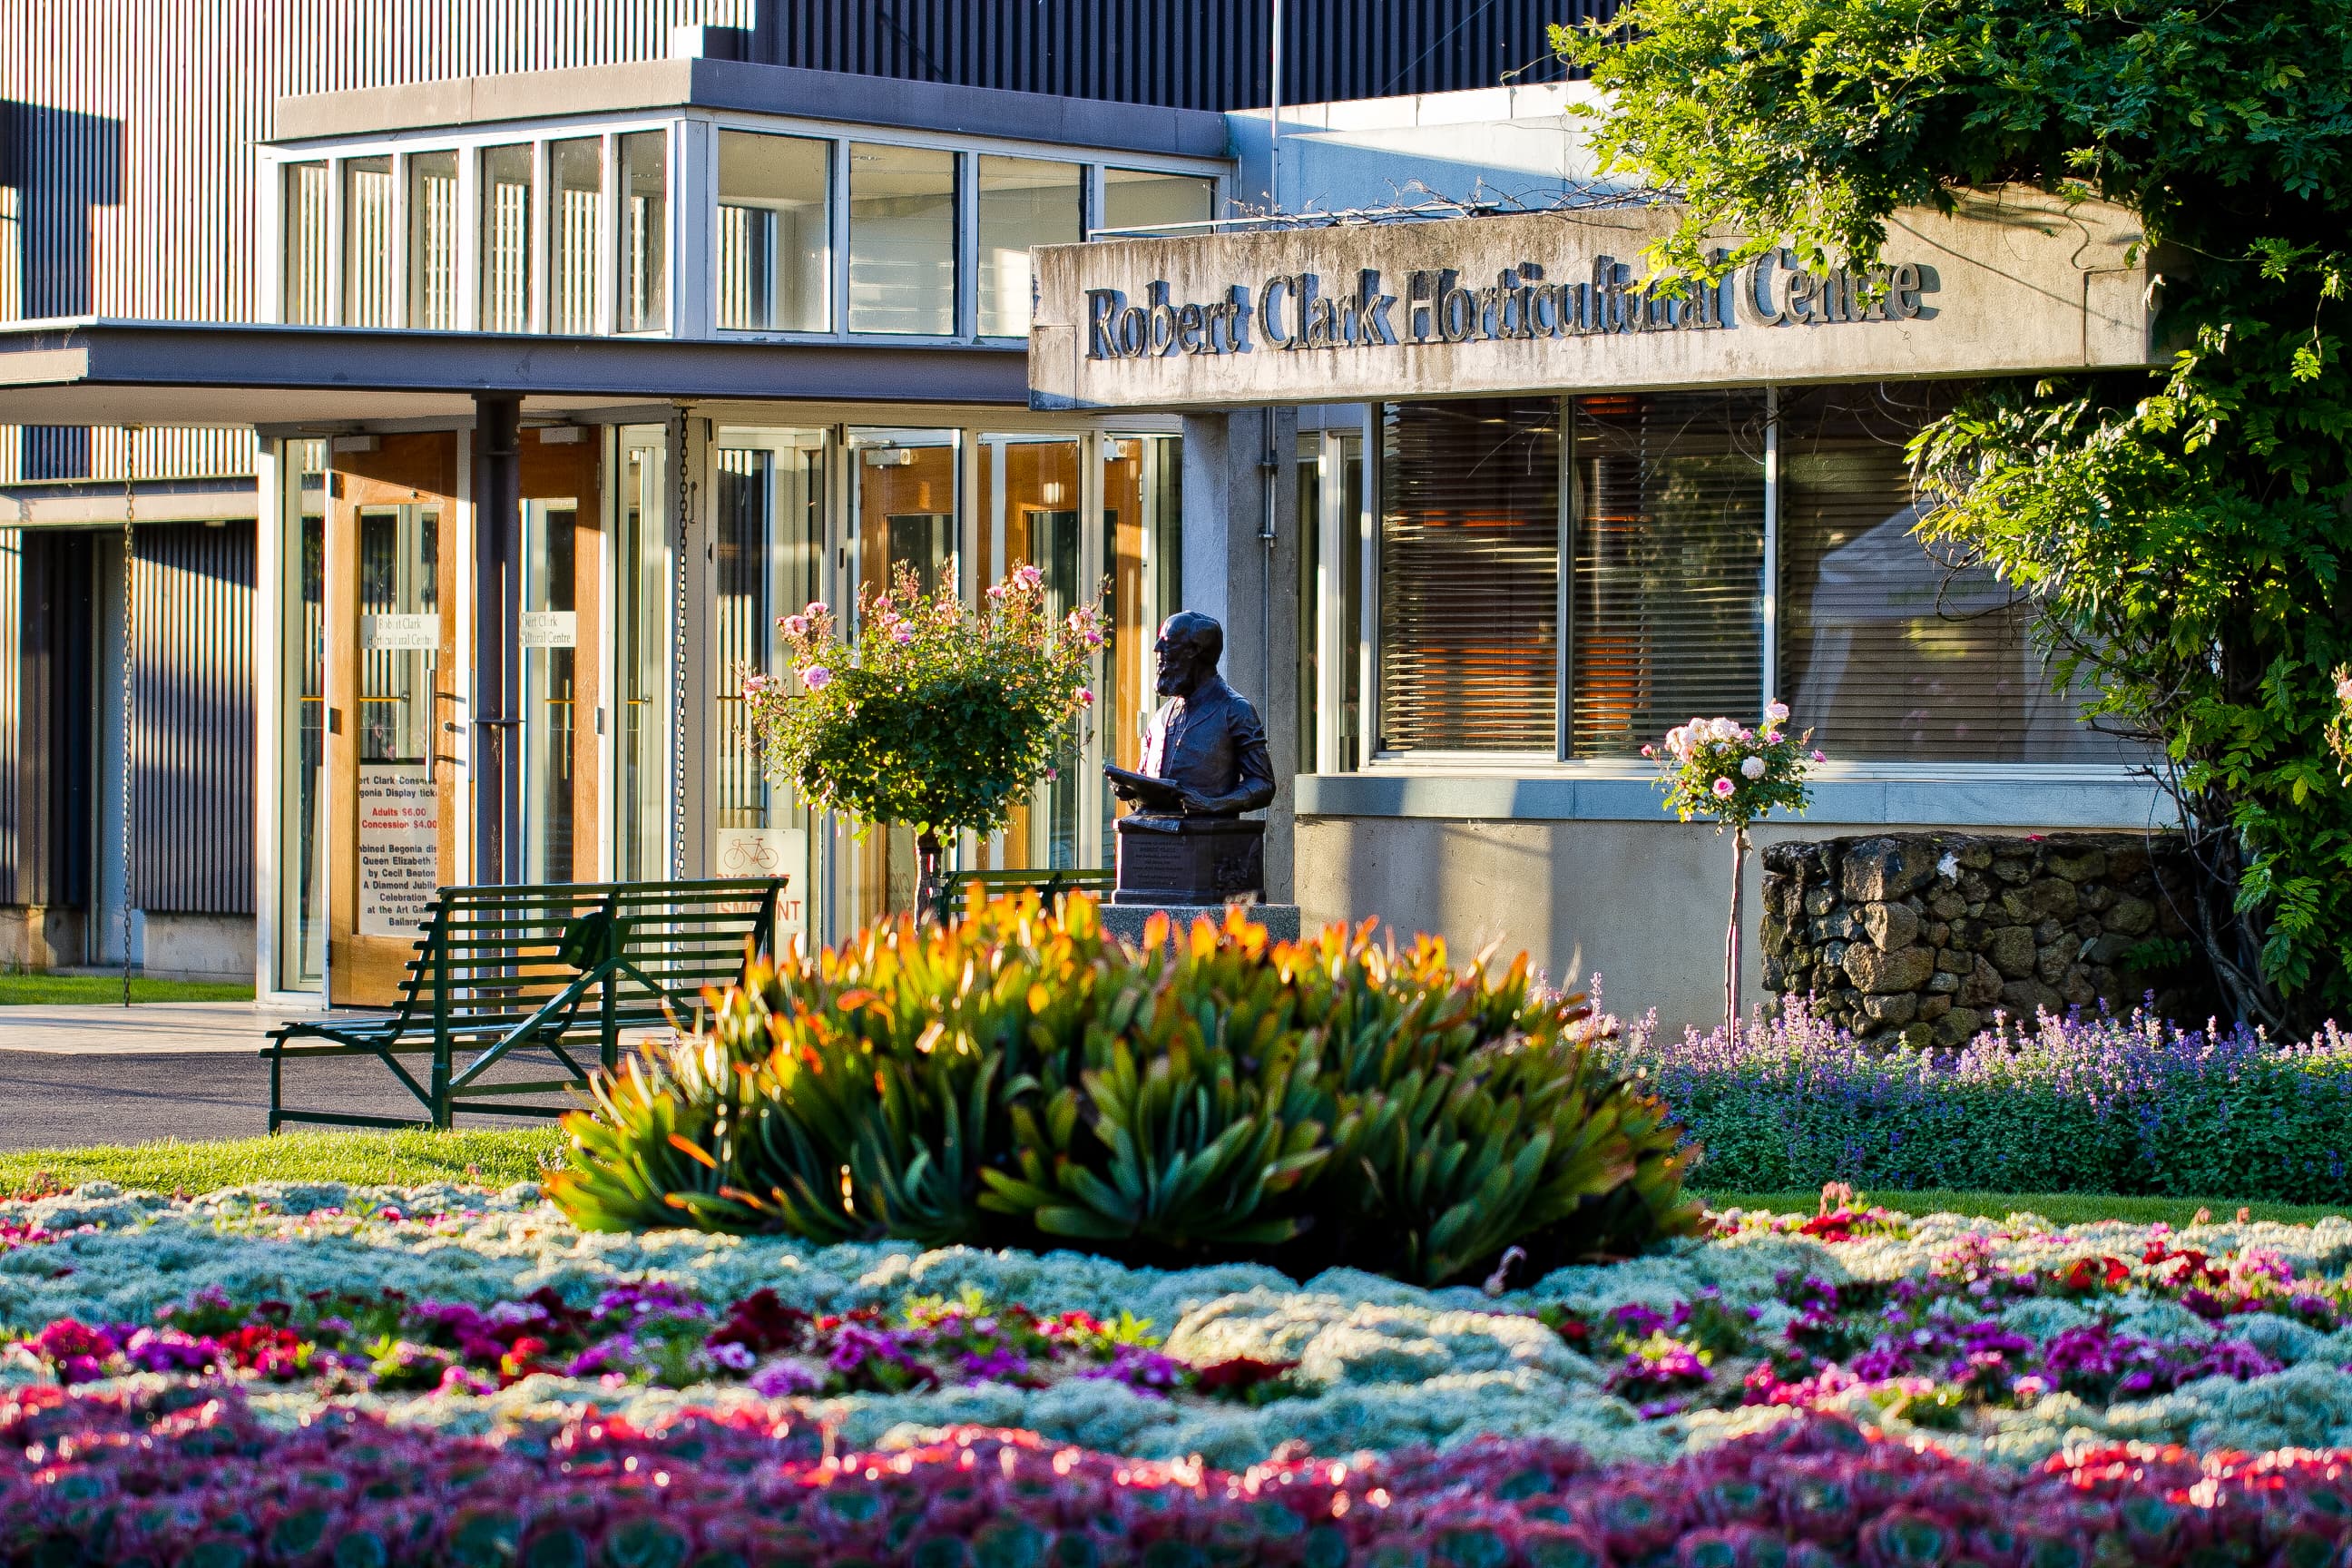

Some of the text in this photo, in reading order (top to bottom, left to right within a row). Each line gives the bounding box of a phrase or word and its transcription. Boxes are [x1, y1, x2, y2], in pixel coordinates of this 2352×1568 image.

[1085, 247, 1920, 360] Robert Clark Horticultural Centre
[379, 617, 422, 630] Rbrt Clark
[538, 614, 558, 627] Clrk
[411, 633, 434, 646] Cetr
[548, 631, 572, 644] Centre
[374, 776, 395, 785] Clark
[386, 788, 416, 799] Display
[372, 808, 426, 817] Adults $6.00
[361, 819, 437, 829] Concession $4.00
[388, 844, 422, 854] Begonia
[362, 856, 389, 866] Queen
[392, 856, 431, 866] Elizabeth
[368, 868, 436, 878] by Cecil Beaton
[363, 881, 369, 889] A
[373, 880, 409, 889] Diamond
[379, 893, 427, 902] Celebration
[367, 906, 376, 914] at
[378, 905, 393, 914] the
[396, 905, 408, 914] Art
